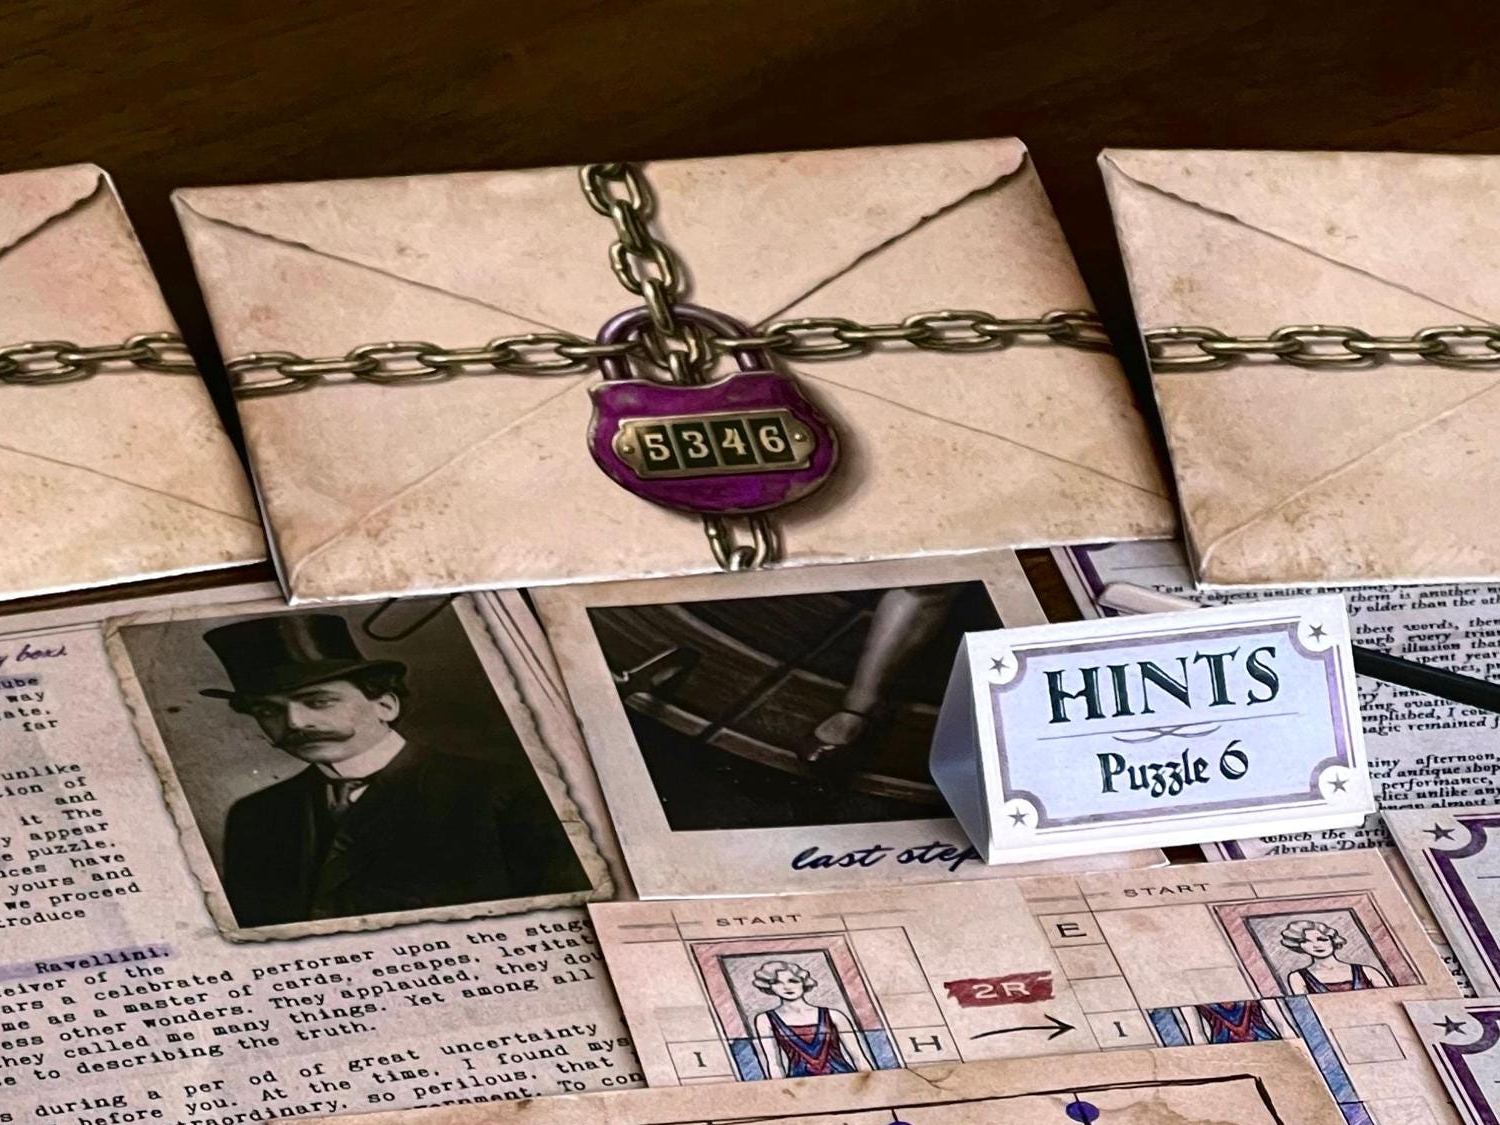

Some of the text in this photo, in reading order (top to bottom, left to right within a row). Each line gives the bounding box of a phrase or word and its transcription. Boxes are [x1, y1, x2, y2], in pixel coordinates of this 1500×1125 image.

[644, 424, 787, 462] 5346
[1411, 599, 1447, 610] than
[1356, 622, 1394, 635] these
[1402, 641, 1461, 655] illusion
[1043, 643, 1281, 725] HINTS
[1408, 716, 1487, 731] remained
[1, 763, 82, 782] unlike
[1097, 738, 1250, 800] Puzzle 6
[1396, 764, 1461, 781] antique
[1415, 787, 1469, 801] unlike
[29, 822, 111, 842] appear
[27, 840, 117, 862] puzzle.
[69, 853, 127, 869] have
[791, 843, 888, 872] last
[8, 875, 76, 897] yours
[48, 882, 143, 907] proceed
[1123, 882, 1211, 898] START
[715, 913, 803, 929] START
[1056, 921, 1088, 939] E
[94, 938, 452, 1001] celebrated performer upon
[971, 981, 1031, 1001] 2R
[58, 968, 482, 1042] other wonders. applauded,
[123, 990, 210, 1015] master
[63, 976, 540, 1061] called many things. among
[1112, 1021, 1128, 1038] I
[75, 1021, 378, 1077] describing truth.
[907, 1033, 943, 1054] H
[496, 1044, 570, 1066] found
[695, 1051, 708, 1069] I
[34, 1021, 599, 1121] during great uncertainty
[412, 1070, 540, 1101] perilous,
[554, 1055, 616, 1075] that
